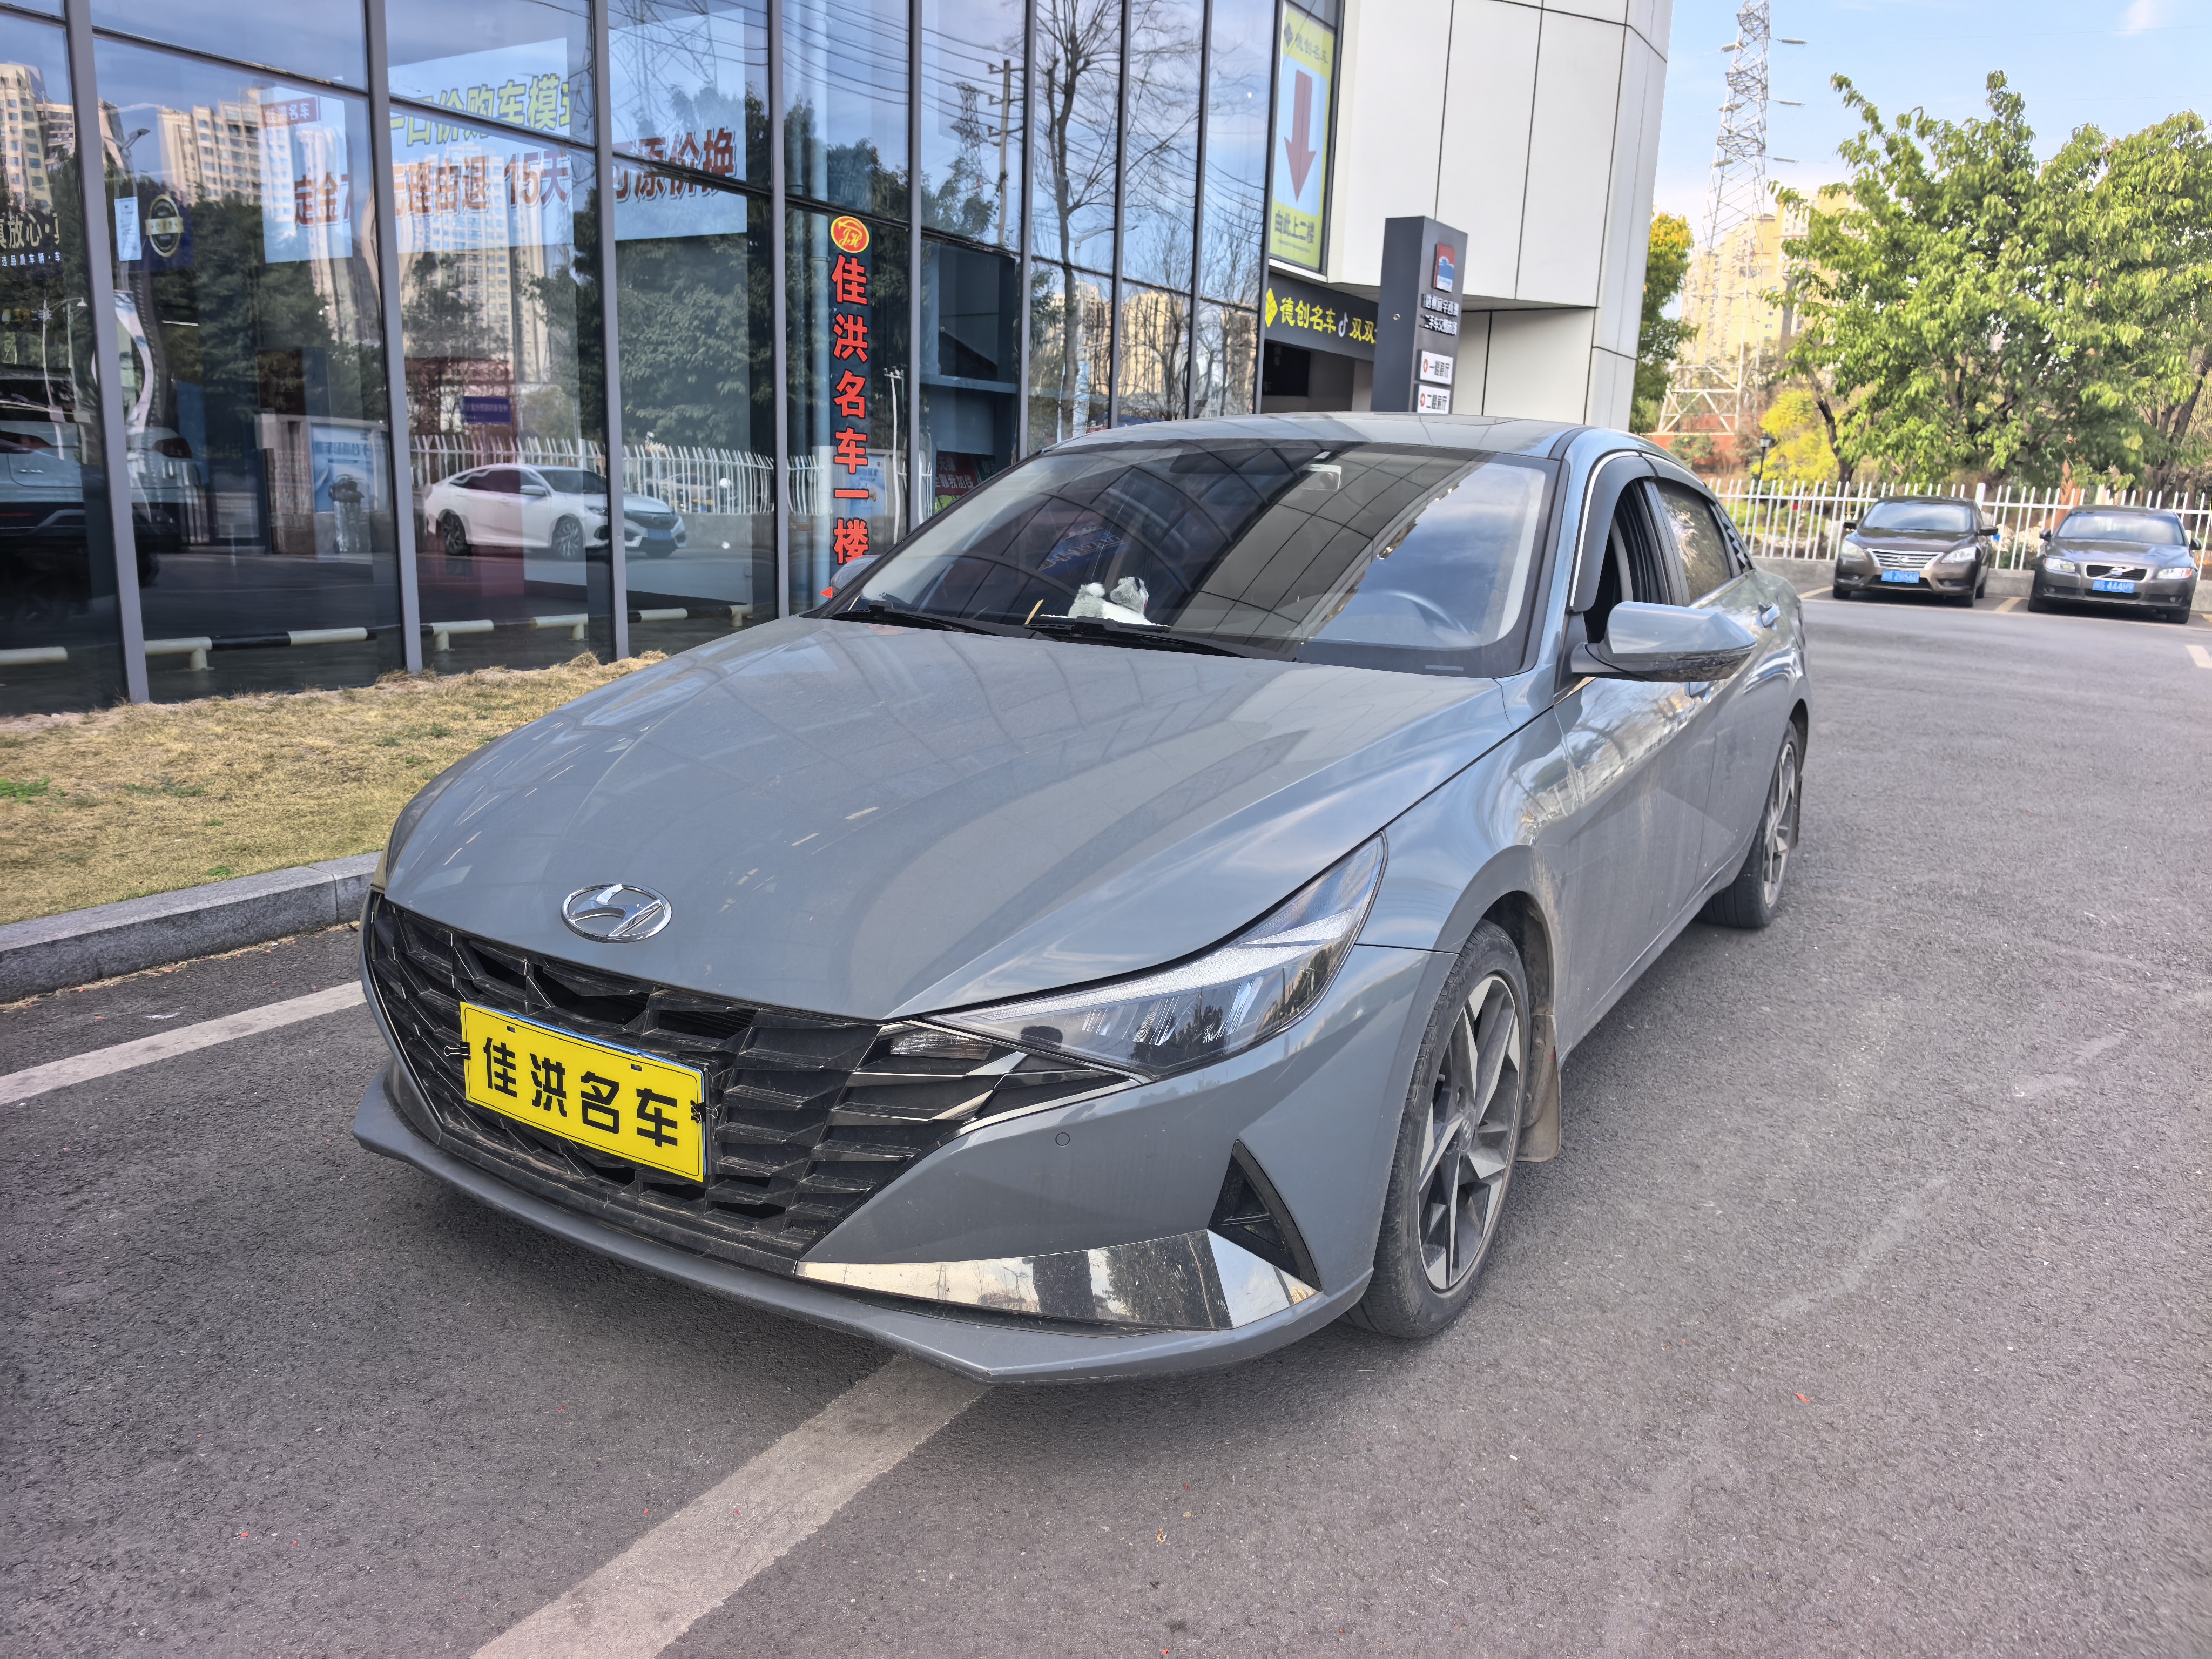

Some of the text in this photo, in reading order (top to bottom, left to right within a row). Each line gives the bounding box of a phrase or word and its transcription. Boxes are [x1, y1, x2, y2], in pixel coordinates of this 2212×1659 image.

[1280, 297, 1377, 344] 德创名车 双双
[832, 255, 868, 563] 佳洪名车一楼
[483, 1037, 678, 1148] 佳洪名车
